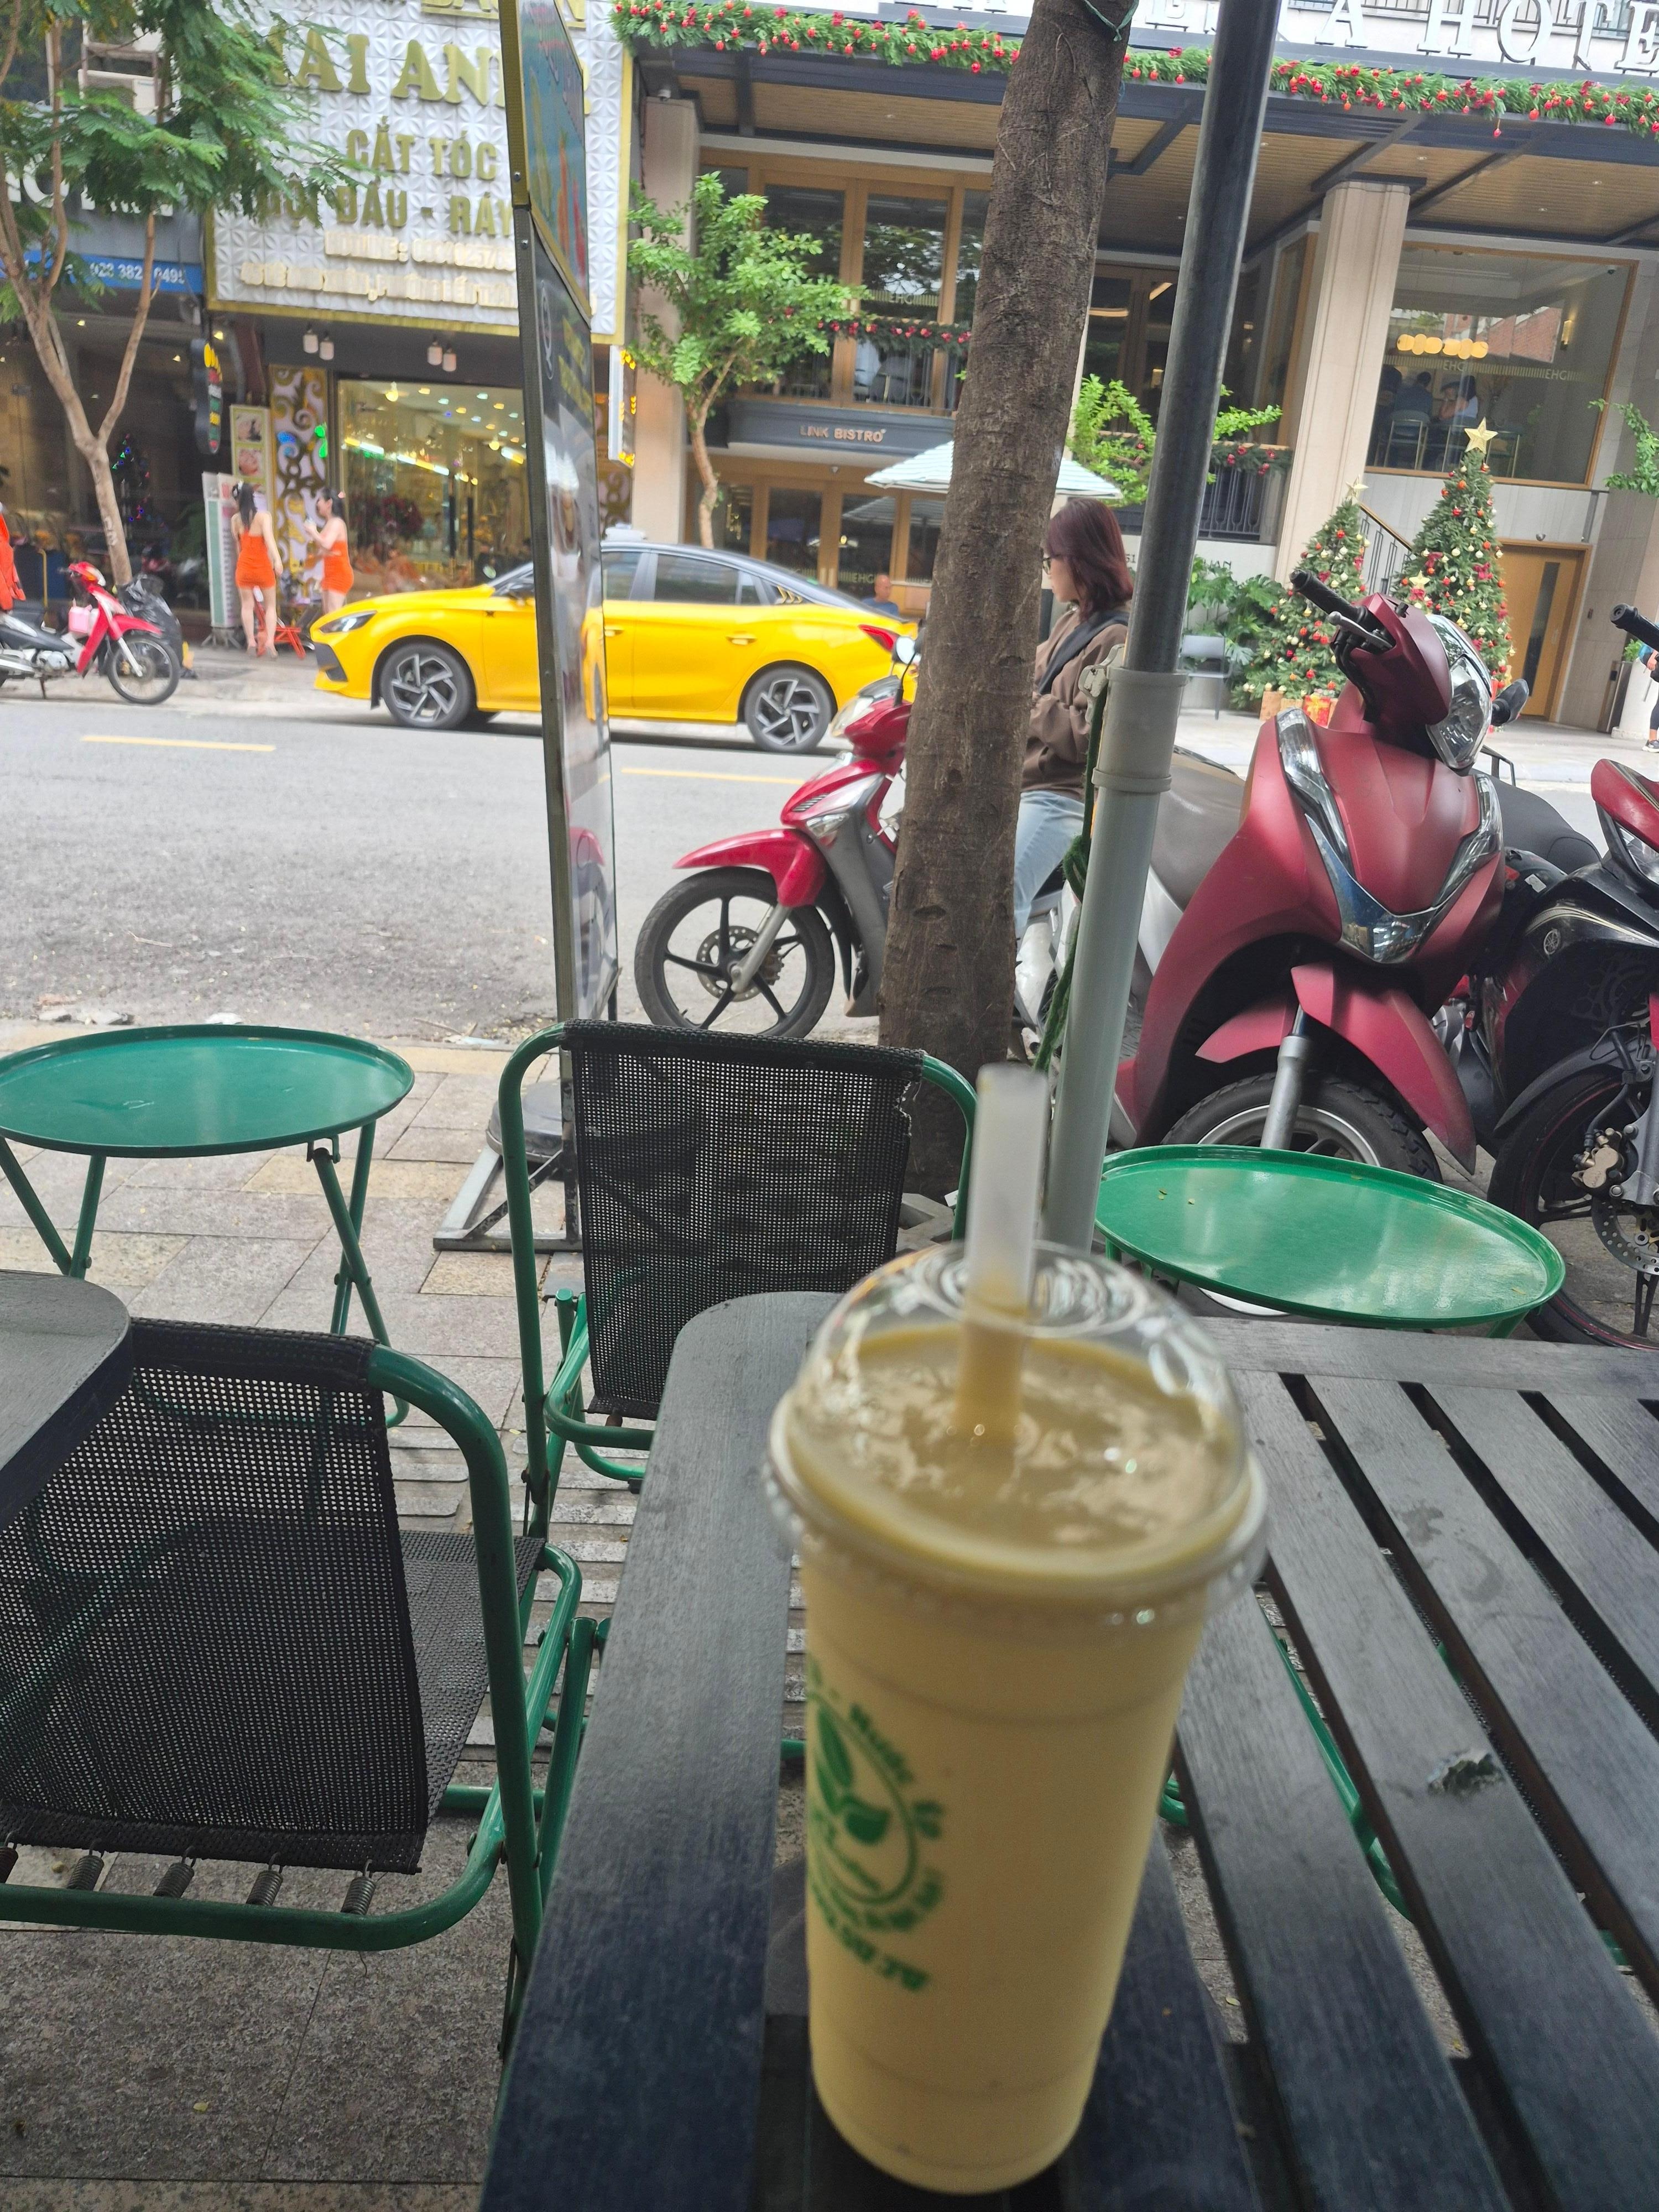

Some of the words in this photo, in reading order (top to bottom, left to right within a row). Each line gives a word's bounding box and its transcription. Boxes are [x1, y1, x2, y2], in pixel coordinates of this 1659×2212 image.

[391, 39, 505, 107] AN
[346, 115, 415, 174] CẮT
[429, 130, 498, 180] TÓC
[118, 263, 144, 280] 382
[1546, 368, 1569, 380] EHG
[799, 425, 829, 438] LINK
[834, 427, 884, 442] BISTRO
[853, 572, 874, 584] EHG
